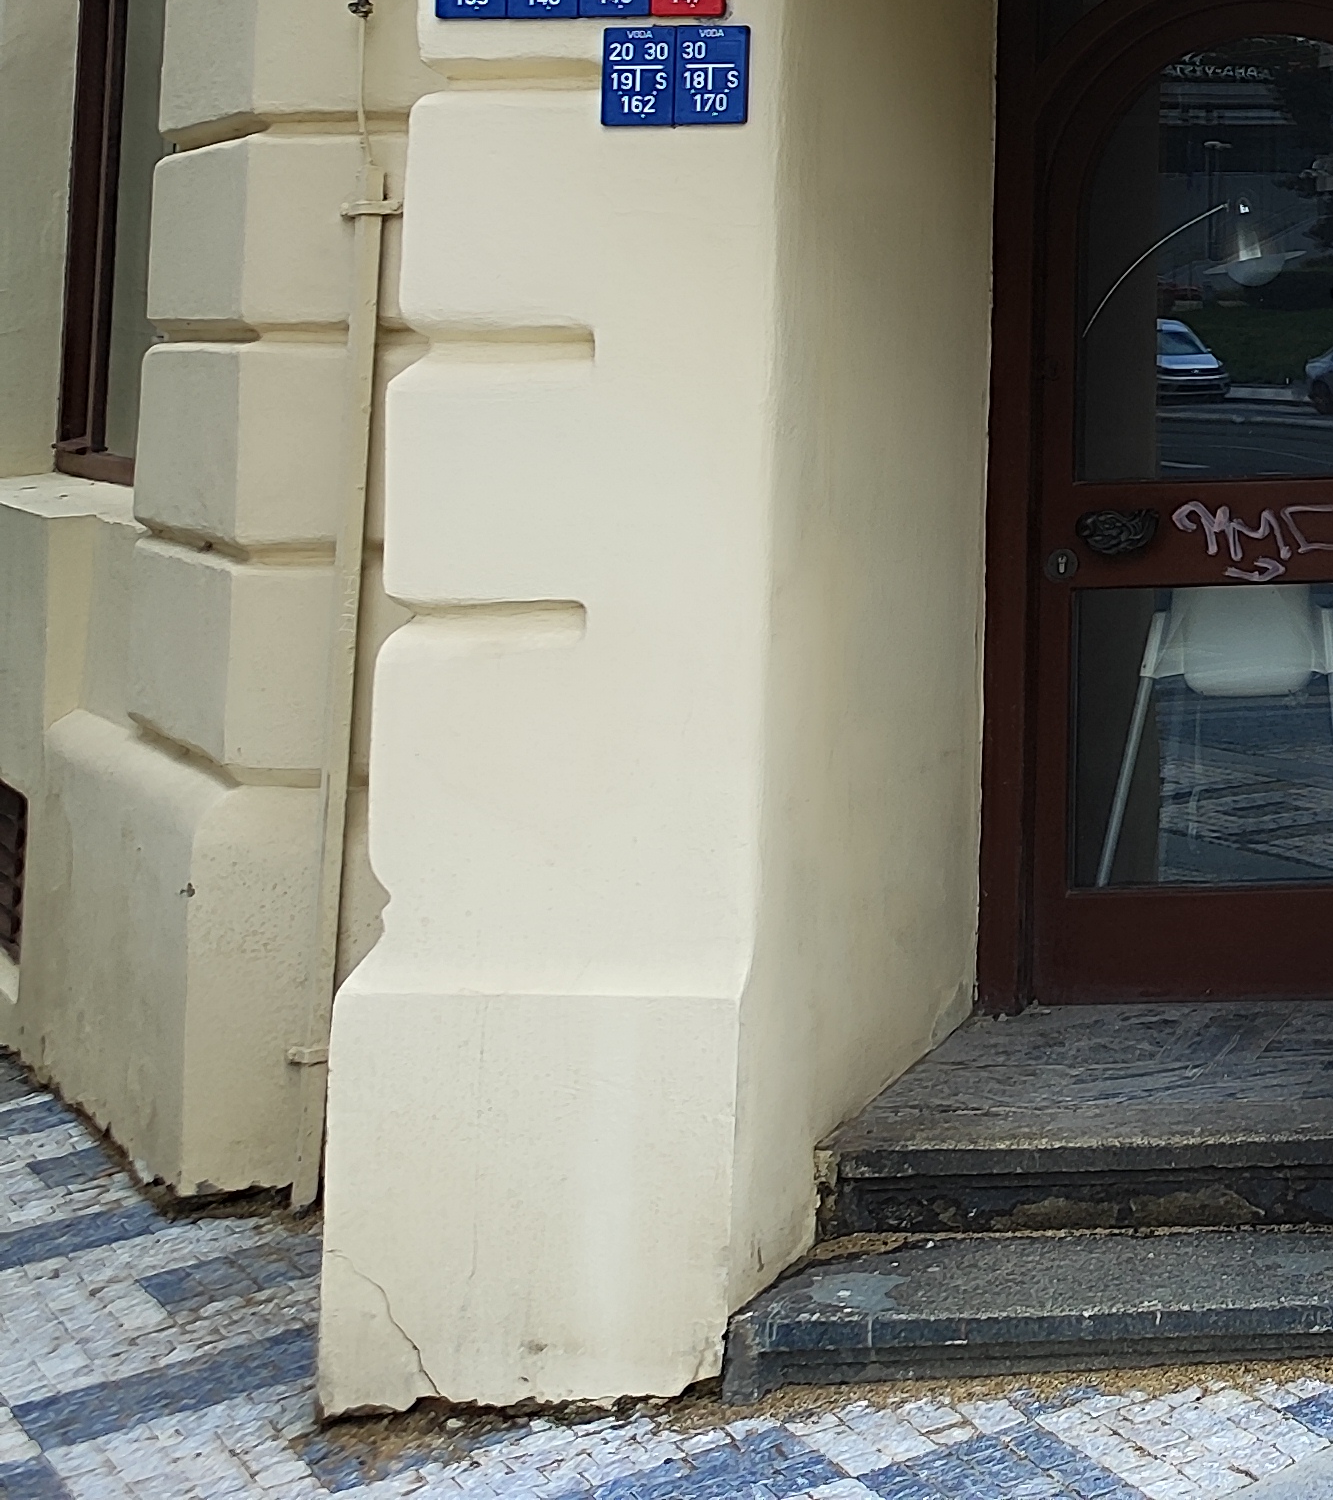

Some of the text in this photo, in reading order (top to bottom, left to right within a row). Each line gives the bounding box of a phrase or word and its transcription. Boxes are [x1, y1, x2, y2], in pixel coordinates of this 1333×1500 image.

[626, 30, 653, 39] VODA
[699, 28, 725, 38] VODA
[609, 42, 669, 61] 20 30
[682, 41, 706, 60] 30
[611, 71, 668, 90] 19 S
[683, 70, 739, 89] 18 S
[620, 95, 656, 114] 162
[693, 93, 728, 112] 170
